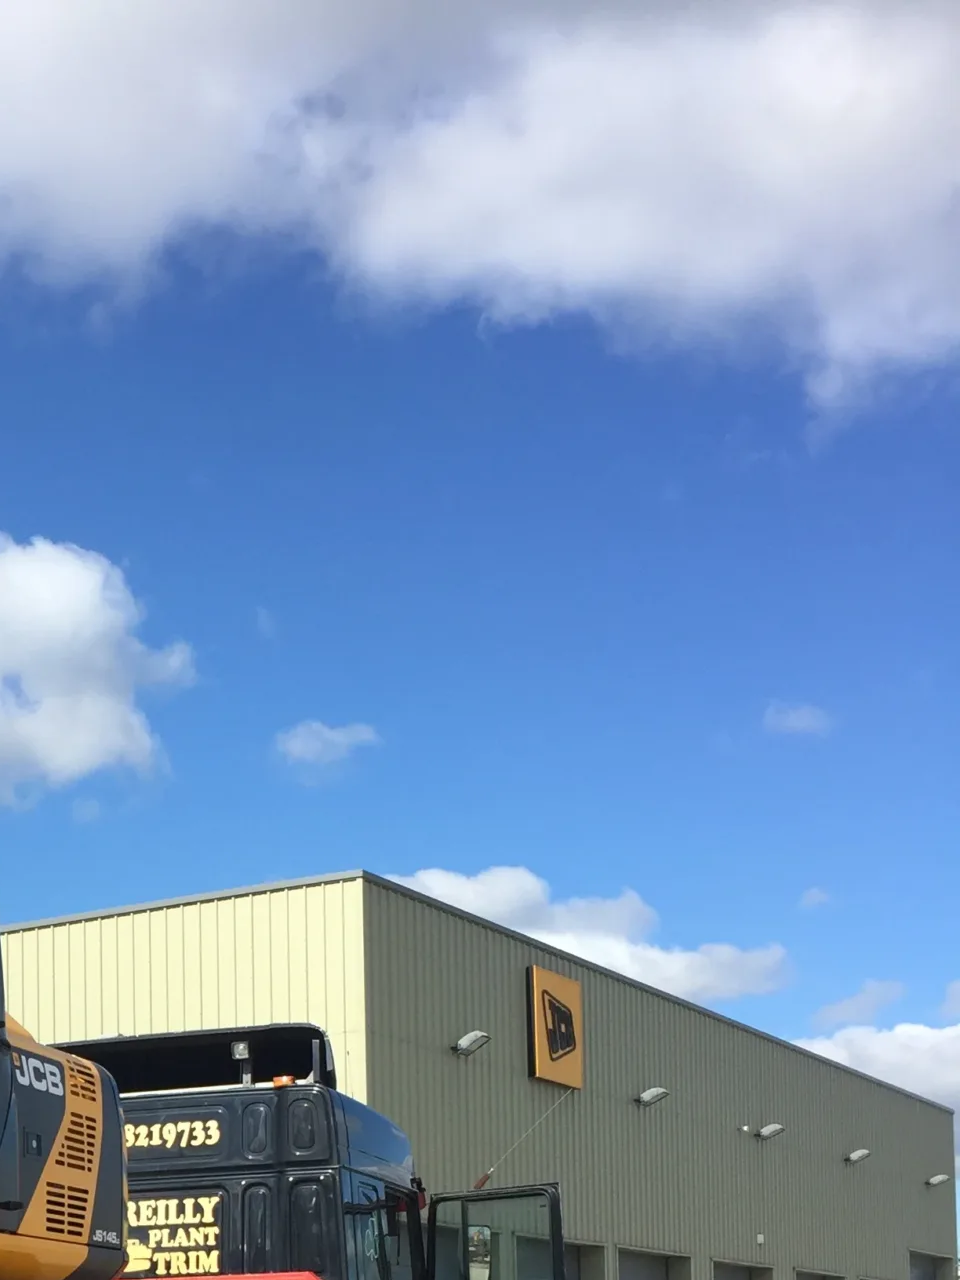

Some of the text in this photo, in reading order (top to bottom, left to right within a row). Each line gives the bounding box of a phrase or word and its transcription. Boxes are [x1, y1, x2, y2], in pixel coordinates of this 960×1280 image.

[15, 1055, 64, 1096] JCB
[148, 1226, 220, 1248] PLANT
[152, 1250, 220, 1275] TRIM
